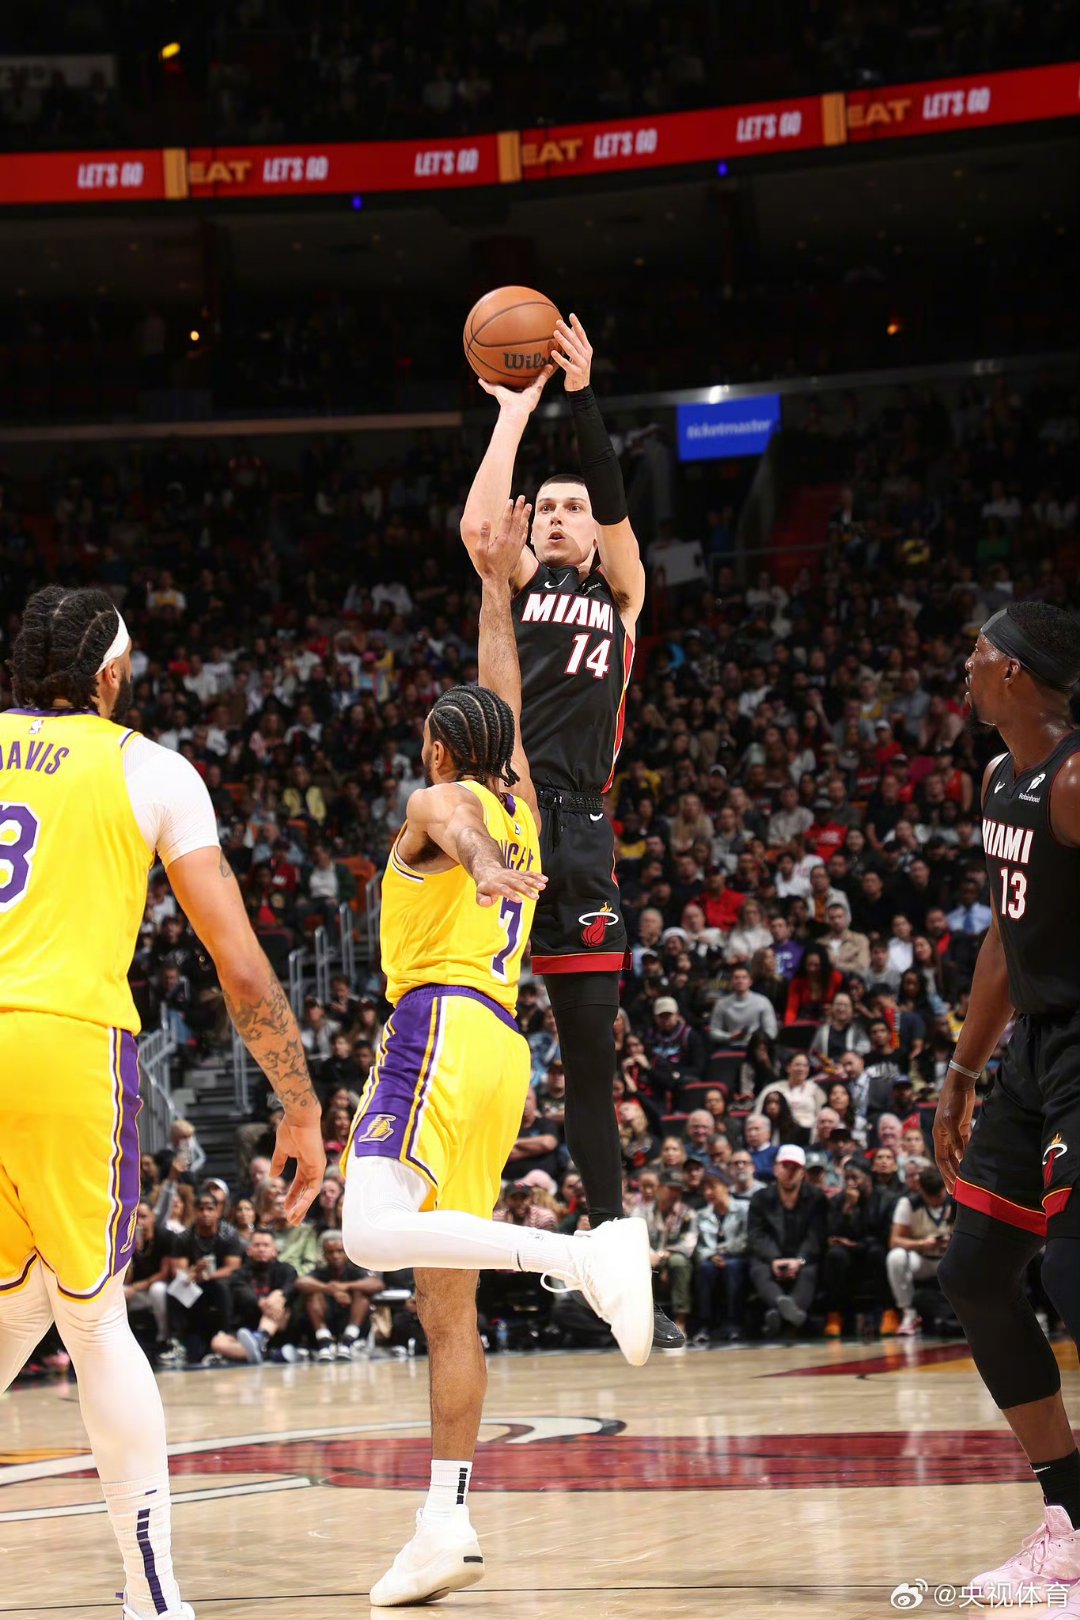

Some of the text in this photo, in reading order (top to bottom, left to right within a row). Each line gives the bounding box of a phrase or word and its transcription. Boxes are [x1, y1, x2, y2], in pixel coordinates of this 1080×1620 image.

[923, 87, 990, 119] LET'S GO
[737, 110, 802, 142] LET'S GO
[593, 128, 658, 159] LET'S GO
[77, 161, 144, 188] LET'S GO
[263, 156, 329, 183] LET'S GO
[414, 148, 479, 177] LET'S GO
[521, 592, 614, 635] MIAMI
[564, 632, 613, 679] 14
[1000, 866, 1028, 920] 13
